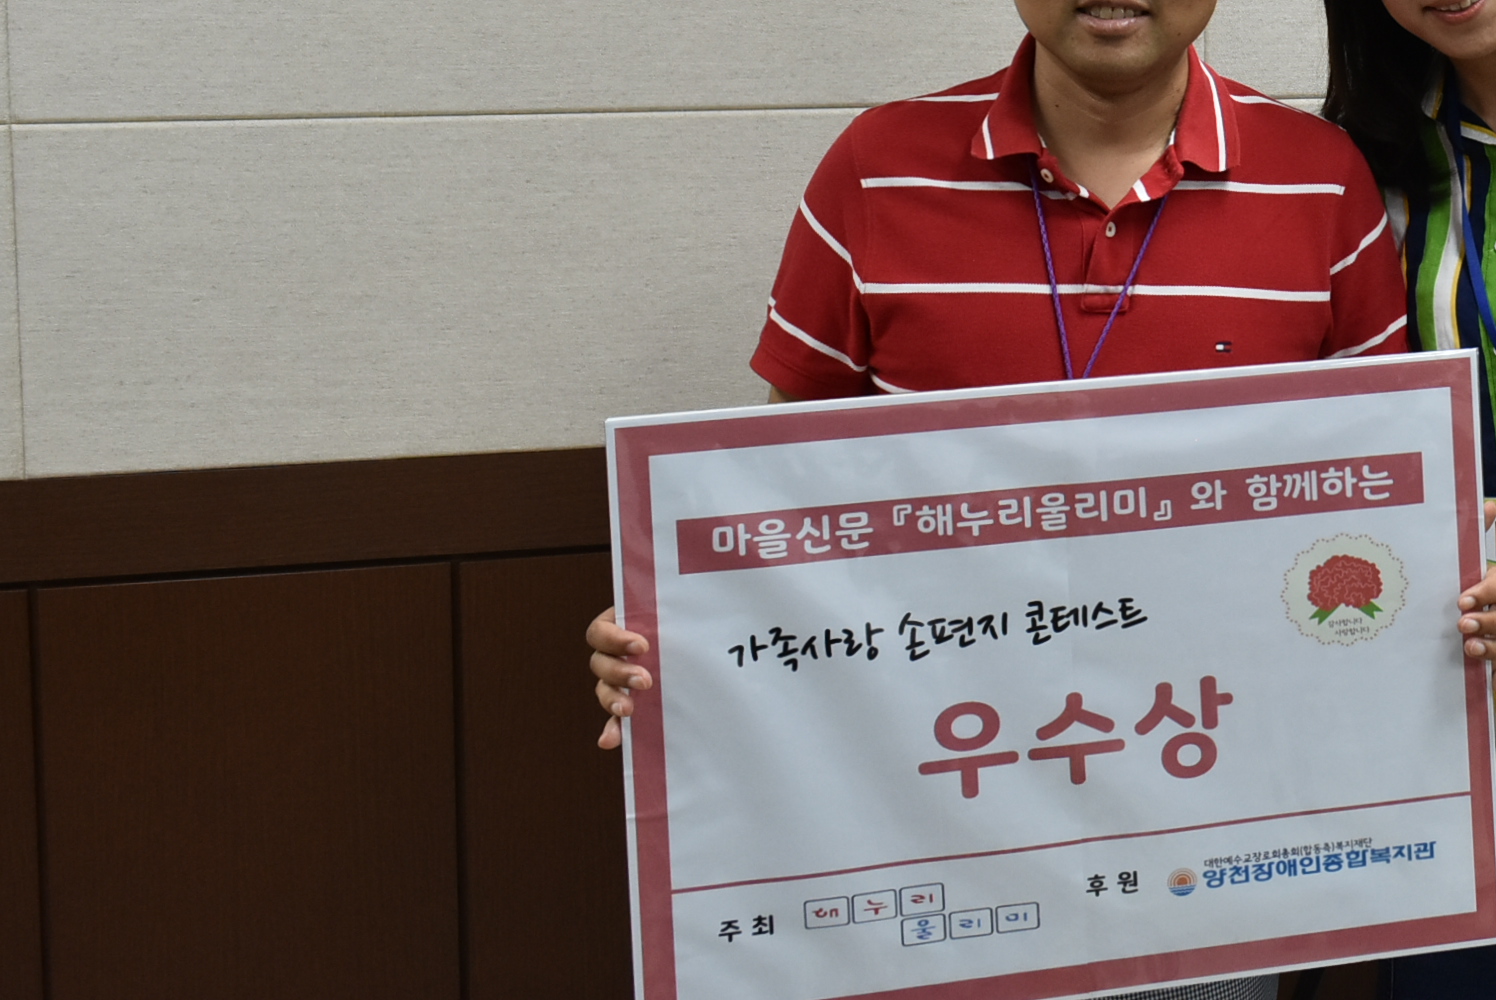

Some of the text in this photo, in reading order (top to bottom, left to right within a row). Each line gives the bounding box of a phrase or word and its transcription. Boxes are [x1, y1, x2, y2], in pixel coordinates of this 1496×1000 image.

[711, 511, 874, 560] 마을신문
[1190, 479, 1228, 511] 와
[1246, 465, 1394, 512] 함께하는
[728, 597, 1148, 672] 가족사랑 손편지 콘테스트
[917, 674, 1234, 799] 우수상
[1202, 841, 1437, 889] 양천장애인종합복지관
